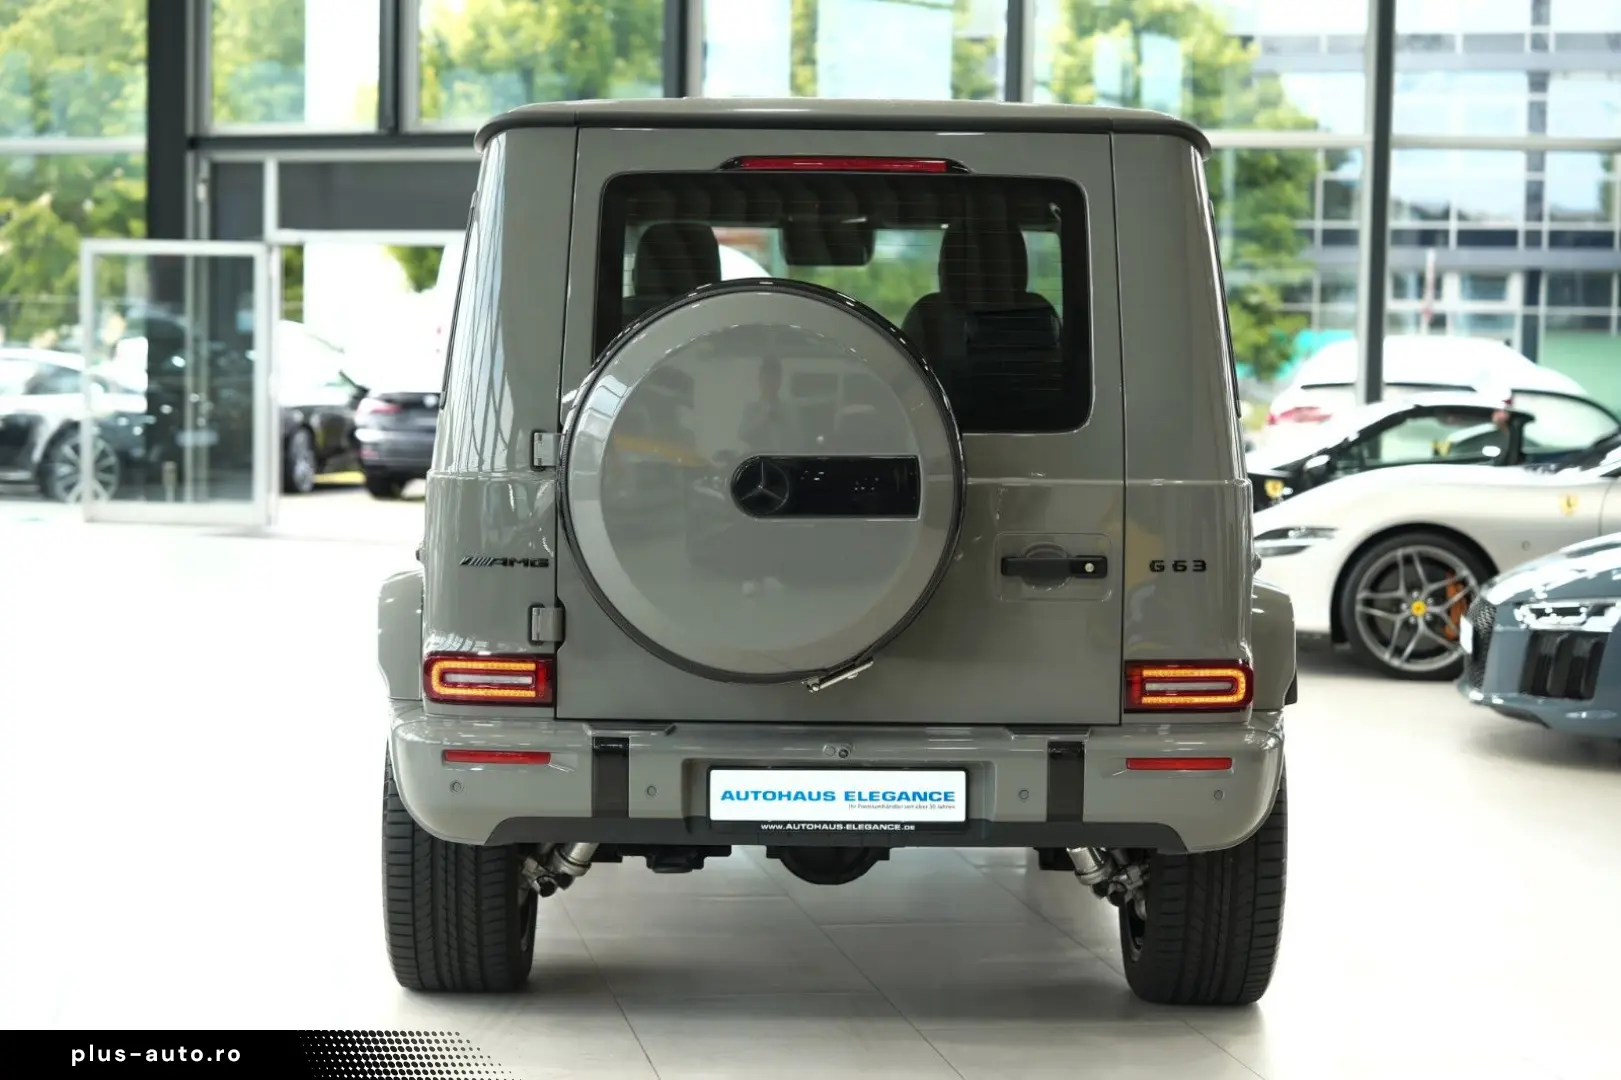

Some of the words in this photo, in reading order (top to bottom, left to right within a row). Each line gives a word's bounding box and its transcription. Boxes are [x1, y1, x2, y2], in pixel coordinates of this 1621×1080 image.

[489, 557, 549, 568] AMG
[1149, 559, 1166, 573] G
[1172, 559, 1207, 573] 63
[720, 790, 836, 801] AUTOHAUS
[843, 791, 956, 802] ELEGANCE
